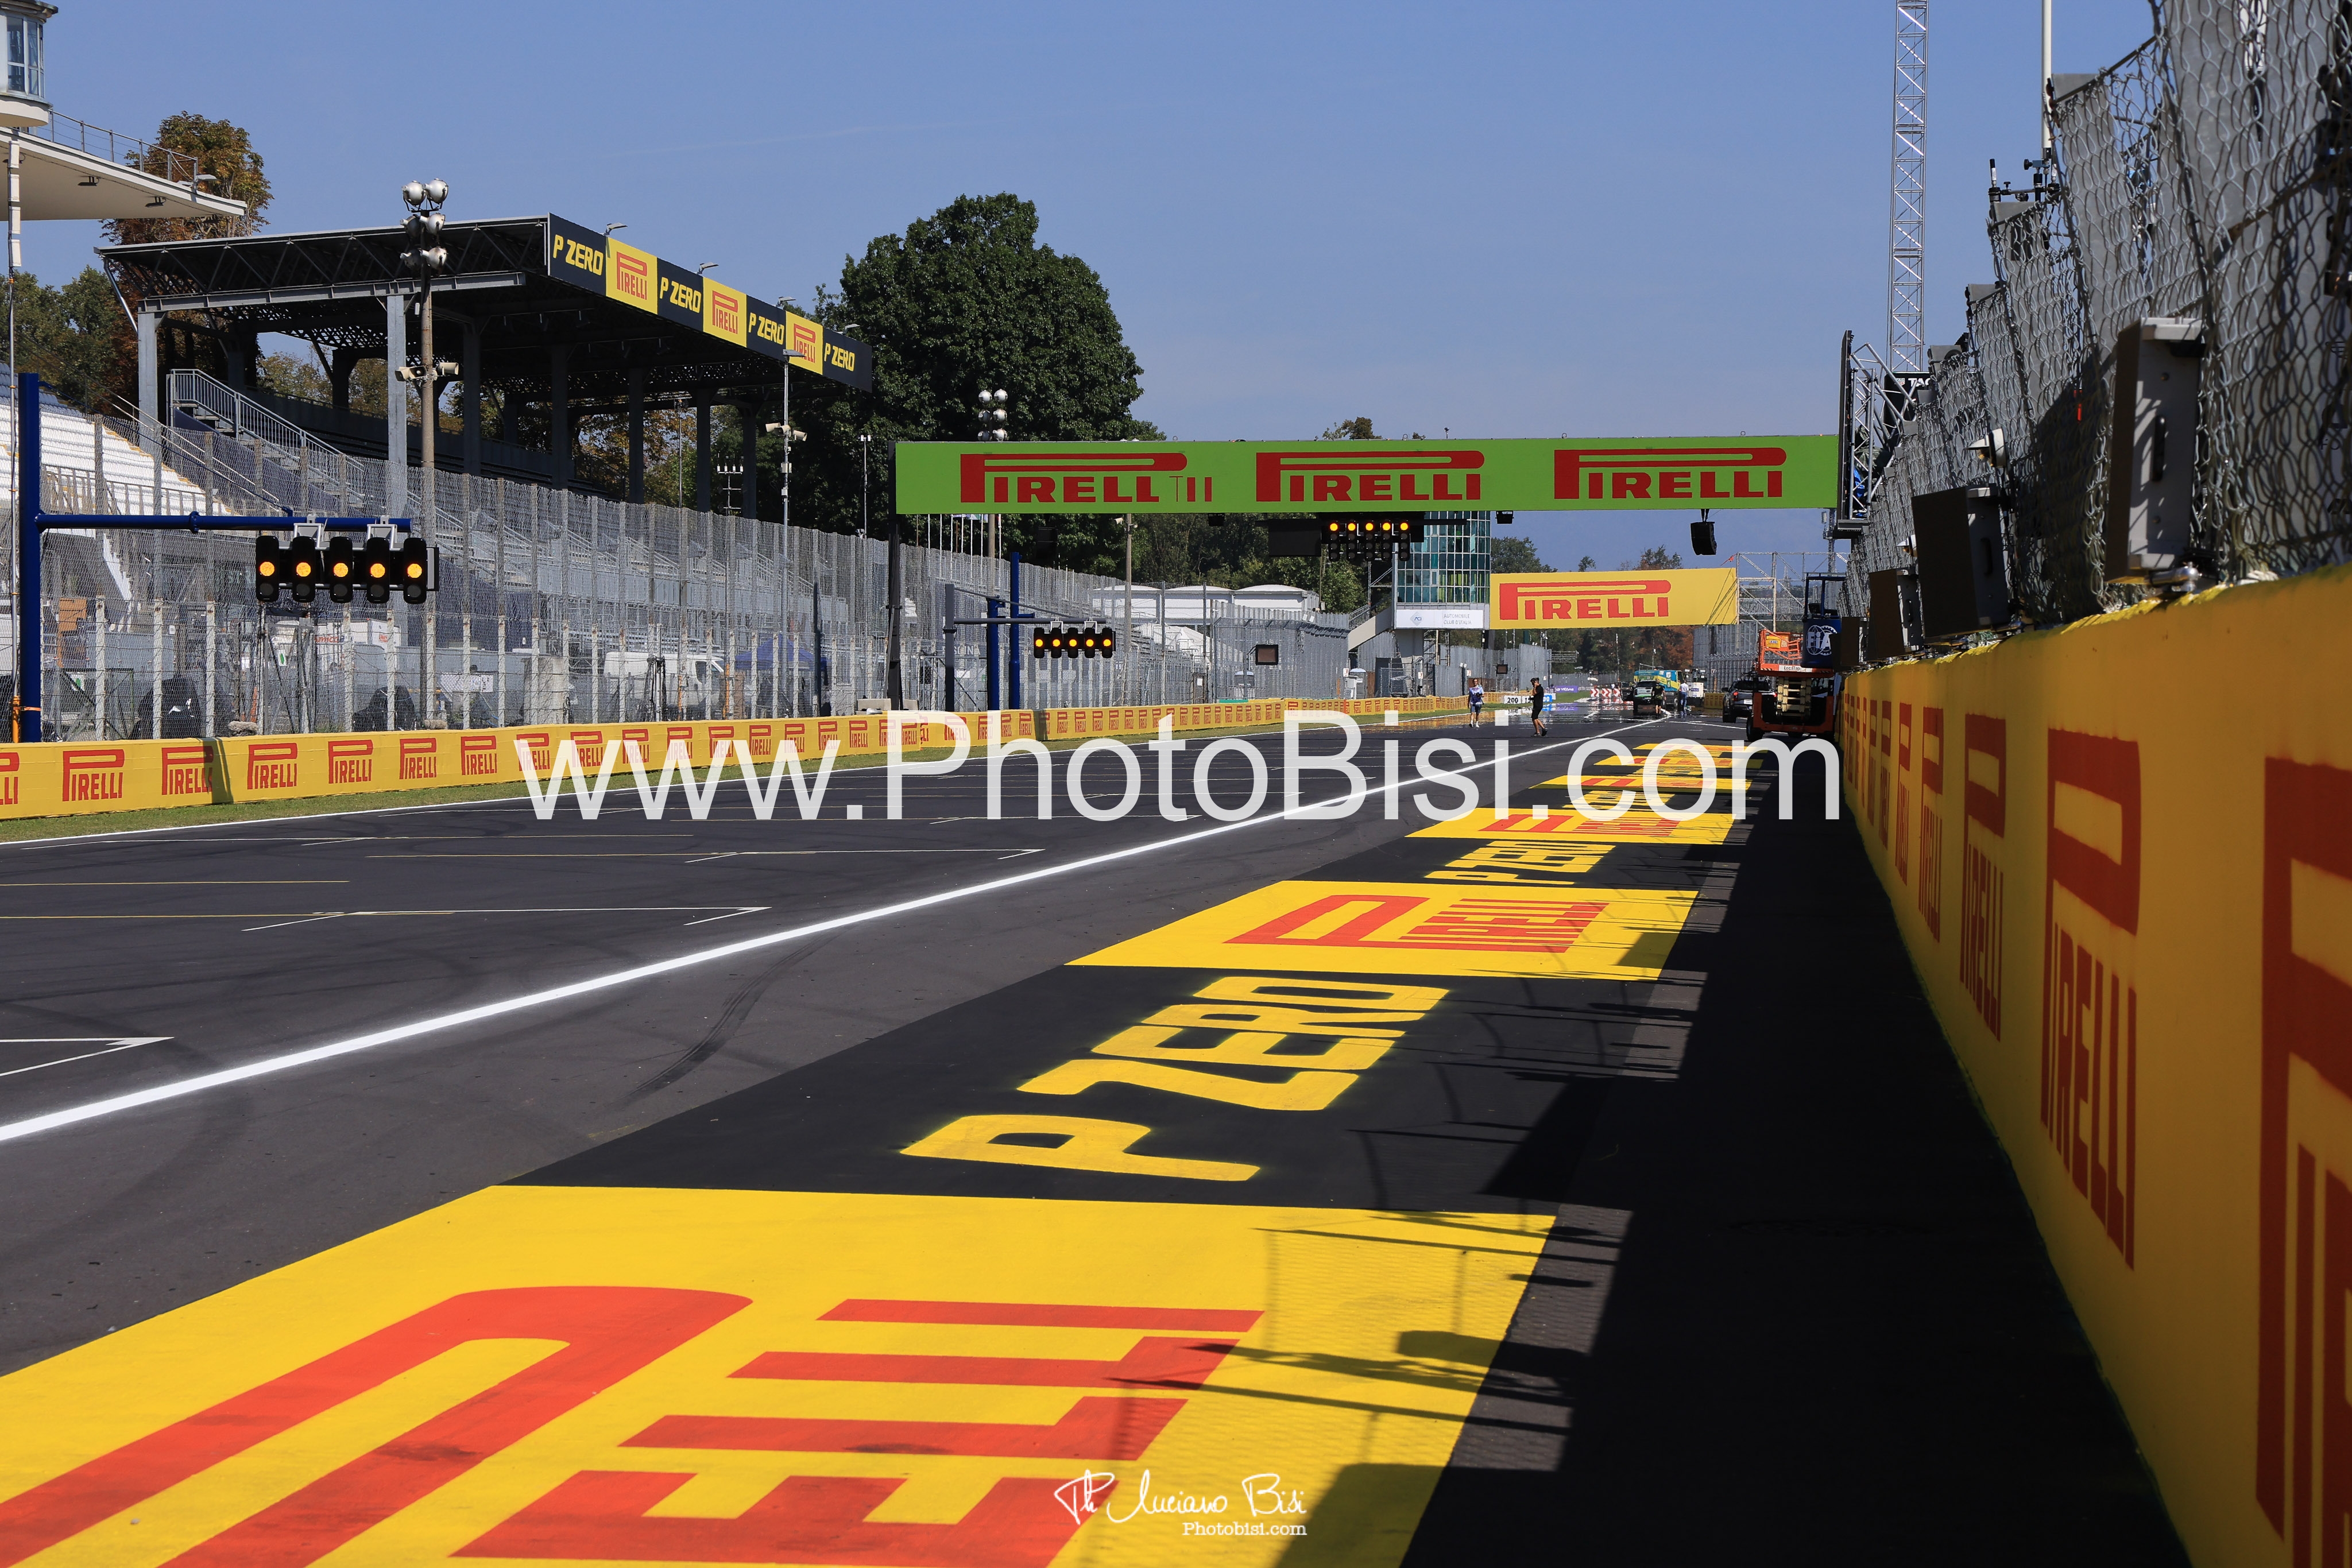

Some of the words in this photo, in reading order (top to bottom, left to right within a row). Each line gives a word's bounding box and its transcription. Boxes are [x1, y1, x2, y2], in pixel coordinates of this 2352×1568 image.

[553, 234, 564, 259] P
[566, 239, 604, 276] ZERO
[616, 251, 647, 300] PIRELLI
[660, 276, 668, 299] P
[670, 280, 702, 313] ZERO
[712, 291, 738, 335] PIRELLI
[749, 312, 756, 333] P
[757, 315, 785, 346] ZERO
[794, 323, 816, 363] PIRELLI
[824, 342, 831, 362] P
[831, 345, 855, 371] ZERO
[1256, 451, 1485, 502] PIRELLI
[1554, 447, 1787, 499] PIRELLI
[1499, 580, 1671, 621] PIRELLI
[667, 727, 693, 761] PIRELLI
[709, 726, 734, 758] PIRELLI
[749, 725, 771, 755] PIRELLI
[784, 723, 805, 753] PIRELLI
[818, 721, 838, 750] PIRELLI
[849, 720, 868, 748] PIRELLI
[901, 719, 918, 745] PIRELLI
[1019, 713, 1032, 735] PIRELLI
[247, 742, 298, 789] PIRELLI
[328, 740, 373, 784] PIRELLI
[400, 738, 437, 780] PIRELLI
[461, 735, 497, 775] PIRELLI
[516, 733, 550, 771] PIRELLI
[570, 731, 603, 768] PIRELLI
[622, 729, 649, 764] PIRELLI
[63, 749, 125, 802] PIRELLI
[161, 746, 214, 795] PIRELLI
[1959, 713, 2006, 1042] PIRELLI
[1223, 894, 1610, 954] PIRELLI
[2040, 728, 2142, 1271] PIRELLI
[1016, 975, 1450, 1112] ZERO
